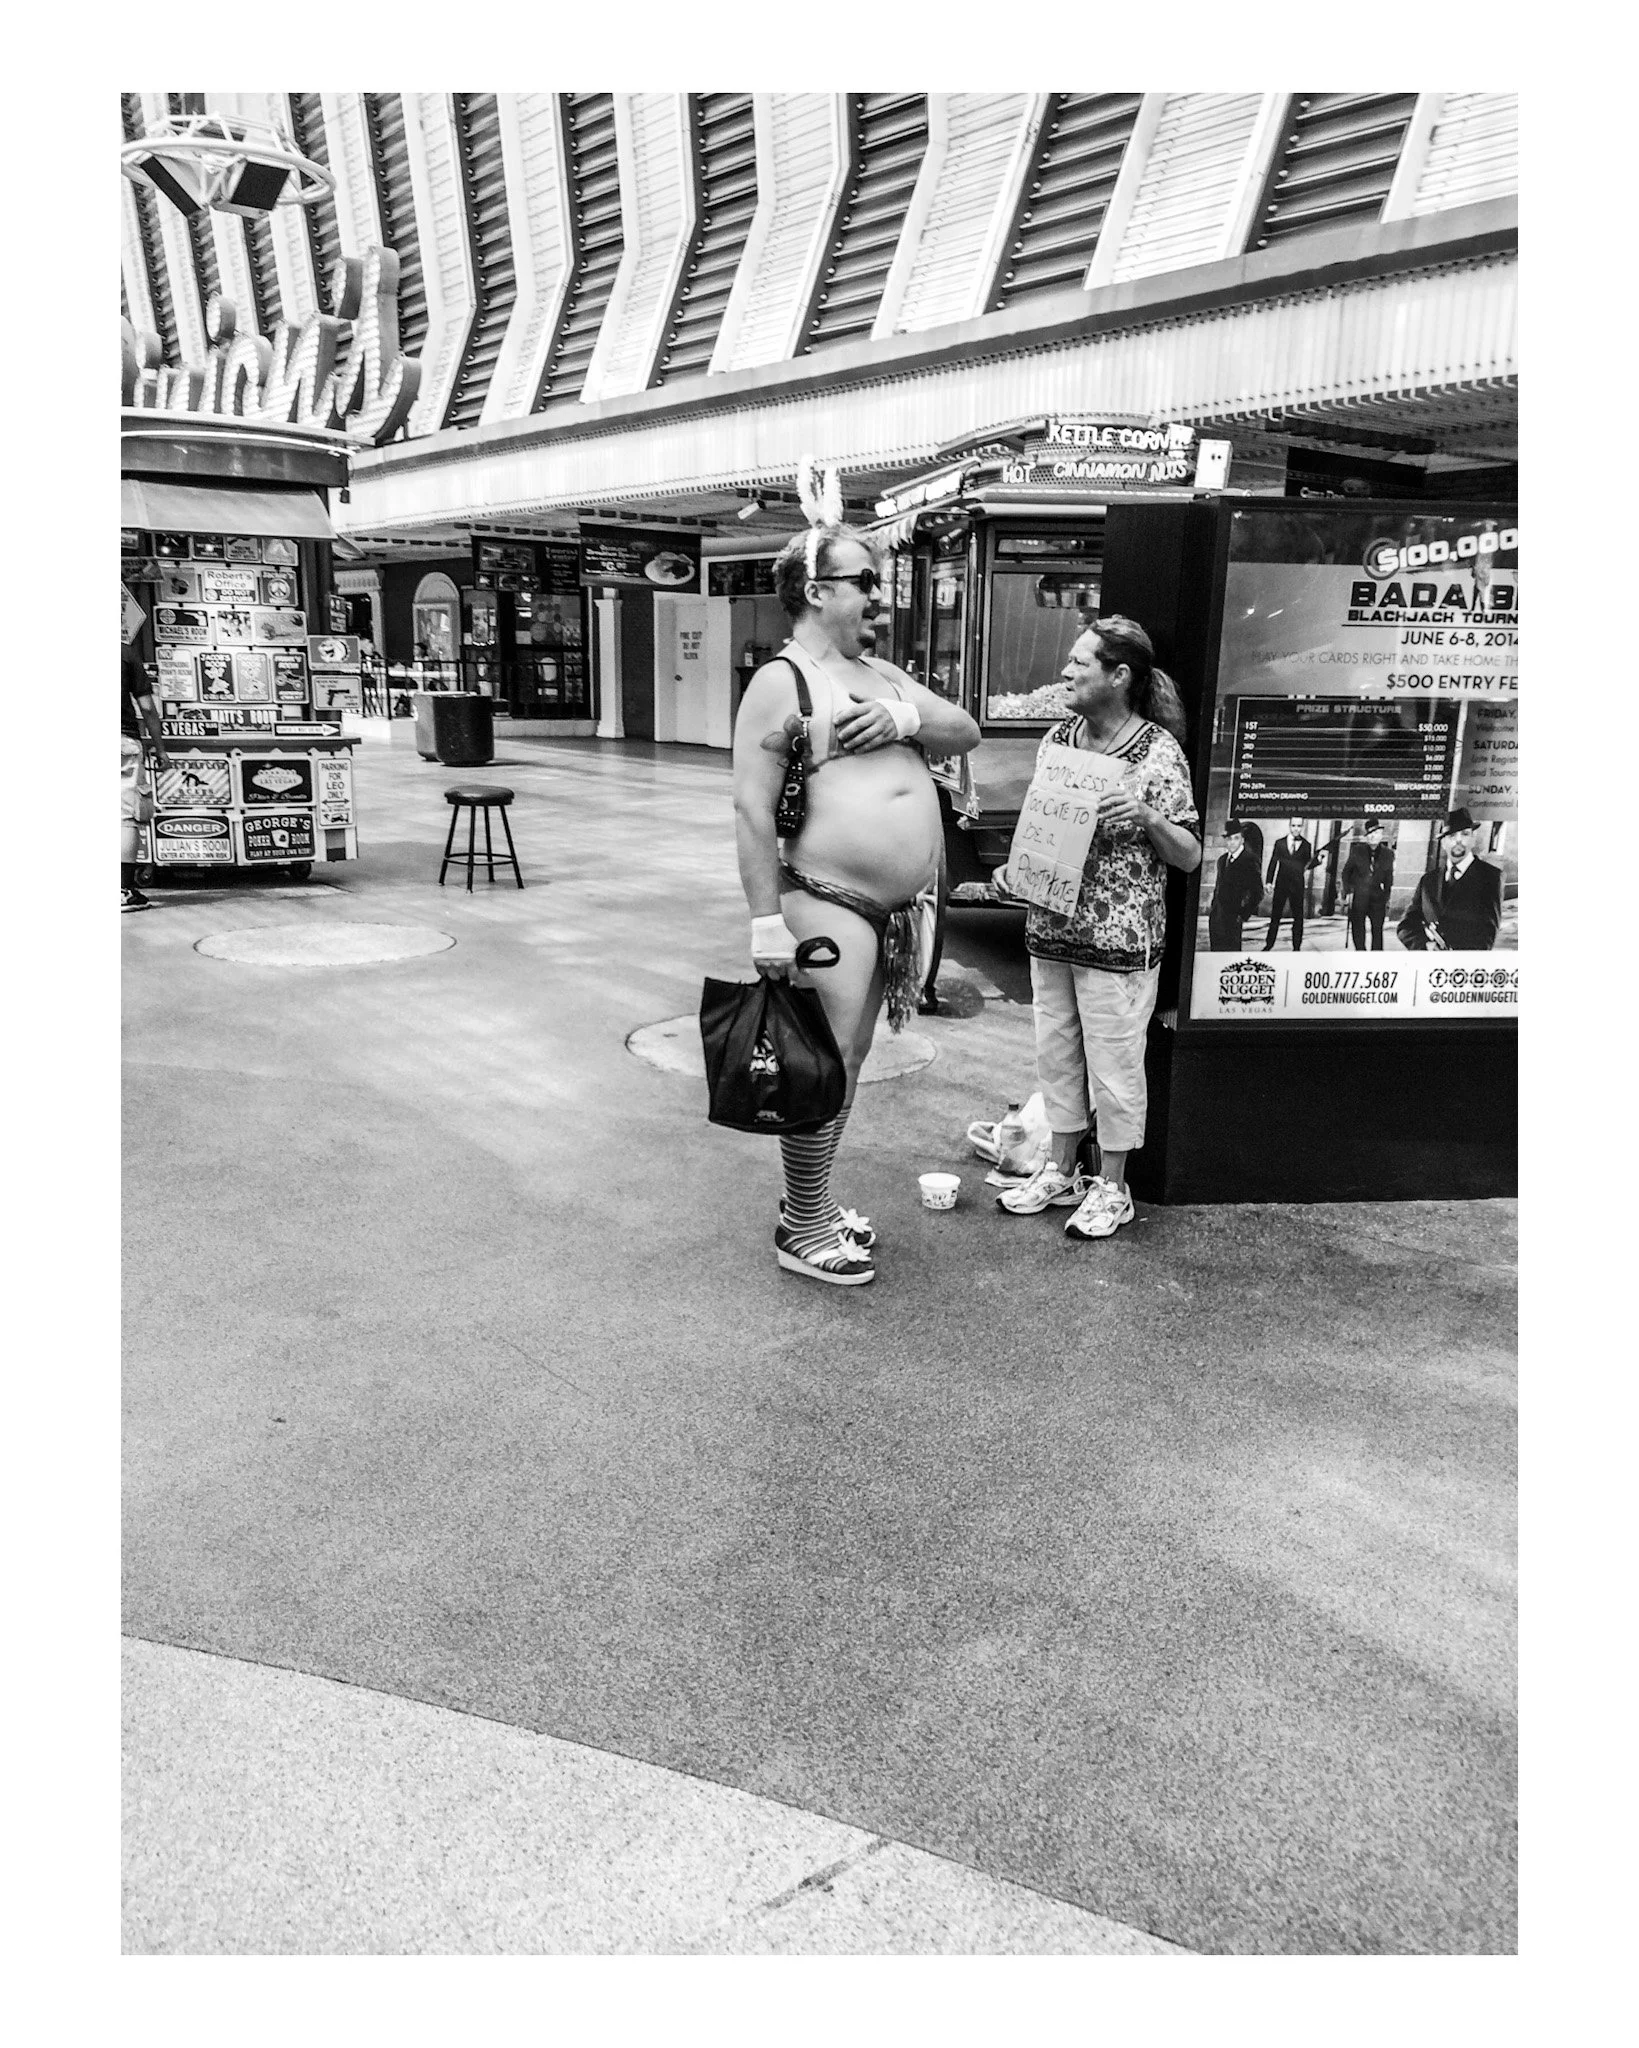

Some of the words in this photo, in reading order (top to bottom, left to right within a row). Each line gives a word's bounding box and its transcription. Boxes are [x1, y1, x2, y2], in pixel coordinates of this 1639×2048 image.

[1047, 424, 1114, 447] KETTLE
[1118, 429, 1170, 450] CORN
[1002, 462, 1037, 484] HOT
[1053, 461, 1147, 480] CINNAMON
[1149, 460, 1188, 483] NUTS
[1377, 528, 1518, 572] $100,000
[207, 570, 252, 580] Robert's
[215, 580, 246, 588] Office
[1350, 581, 1468, 610] BADA
[159, 626, 190, 635] MICHAEL'S
[191, 627, 207, 635] ROOM
[1401, 631, 1445, 645] JUNE
[1449, 632, 1479, 648] 6-8,
[1281, 651, 1315, 664] YOUR
[1319, 652, 1358, 664] CARDS
[1362, 653, 1397, 665] RIGHT
[1400, 653, 1428, 665] AND
[1432, 654, 1460, 665] TAKE
[1463, 654, 1501, 666] HOME
[1386, 674, 1433, 689] $500
[1438, 675, 1494, 689] ENTRY
[1296, 704, 1330, 713] PRIZE
[1333, 705, 1401, 714] STRUCTURE
[1477, 709, 1517, 719] FRIDAY,
[210, 709, 244, 724] MATT'S
[171, 722, 206, 736] VEGAS
[1245, 721, 1258, 730] 1ST
[1418, 723, 1448, 732] $50,000
[321, 763, 348, 771] PARKING
[328, 773, 342, 781] FOR
[326, 781, 344, 790] LEO
[1468, 785, 1512, 796] SUNDAY,
[328, 791, 345, 799] ONLY
[1364, 803, 1395, 813] $5,000
[1072, 806, 1090, 825] TO
[164, 823, 221, 833] DANGER
[244, 816, 311, 833] GEORGE'S
[161, 840, 199, 851] JULIAN'S
[202, 840, 228, 851] ROOM
[247, 835, 271, 847] POKER
[291, 833, 310, 845] ROOM
[1219, 974, 1276, 985] GOLDEN
[1304, 972, 1398, 989] 800.777.5687
[1219, 985, 1276, 996] NUGGET
[1302, 991, 1398, 1004] GOLDENNUGGET.COM
